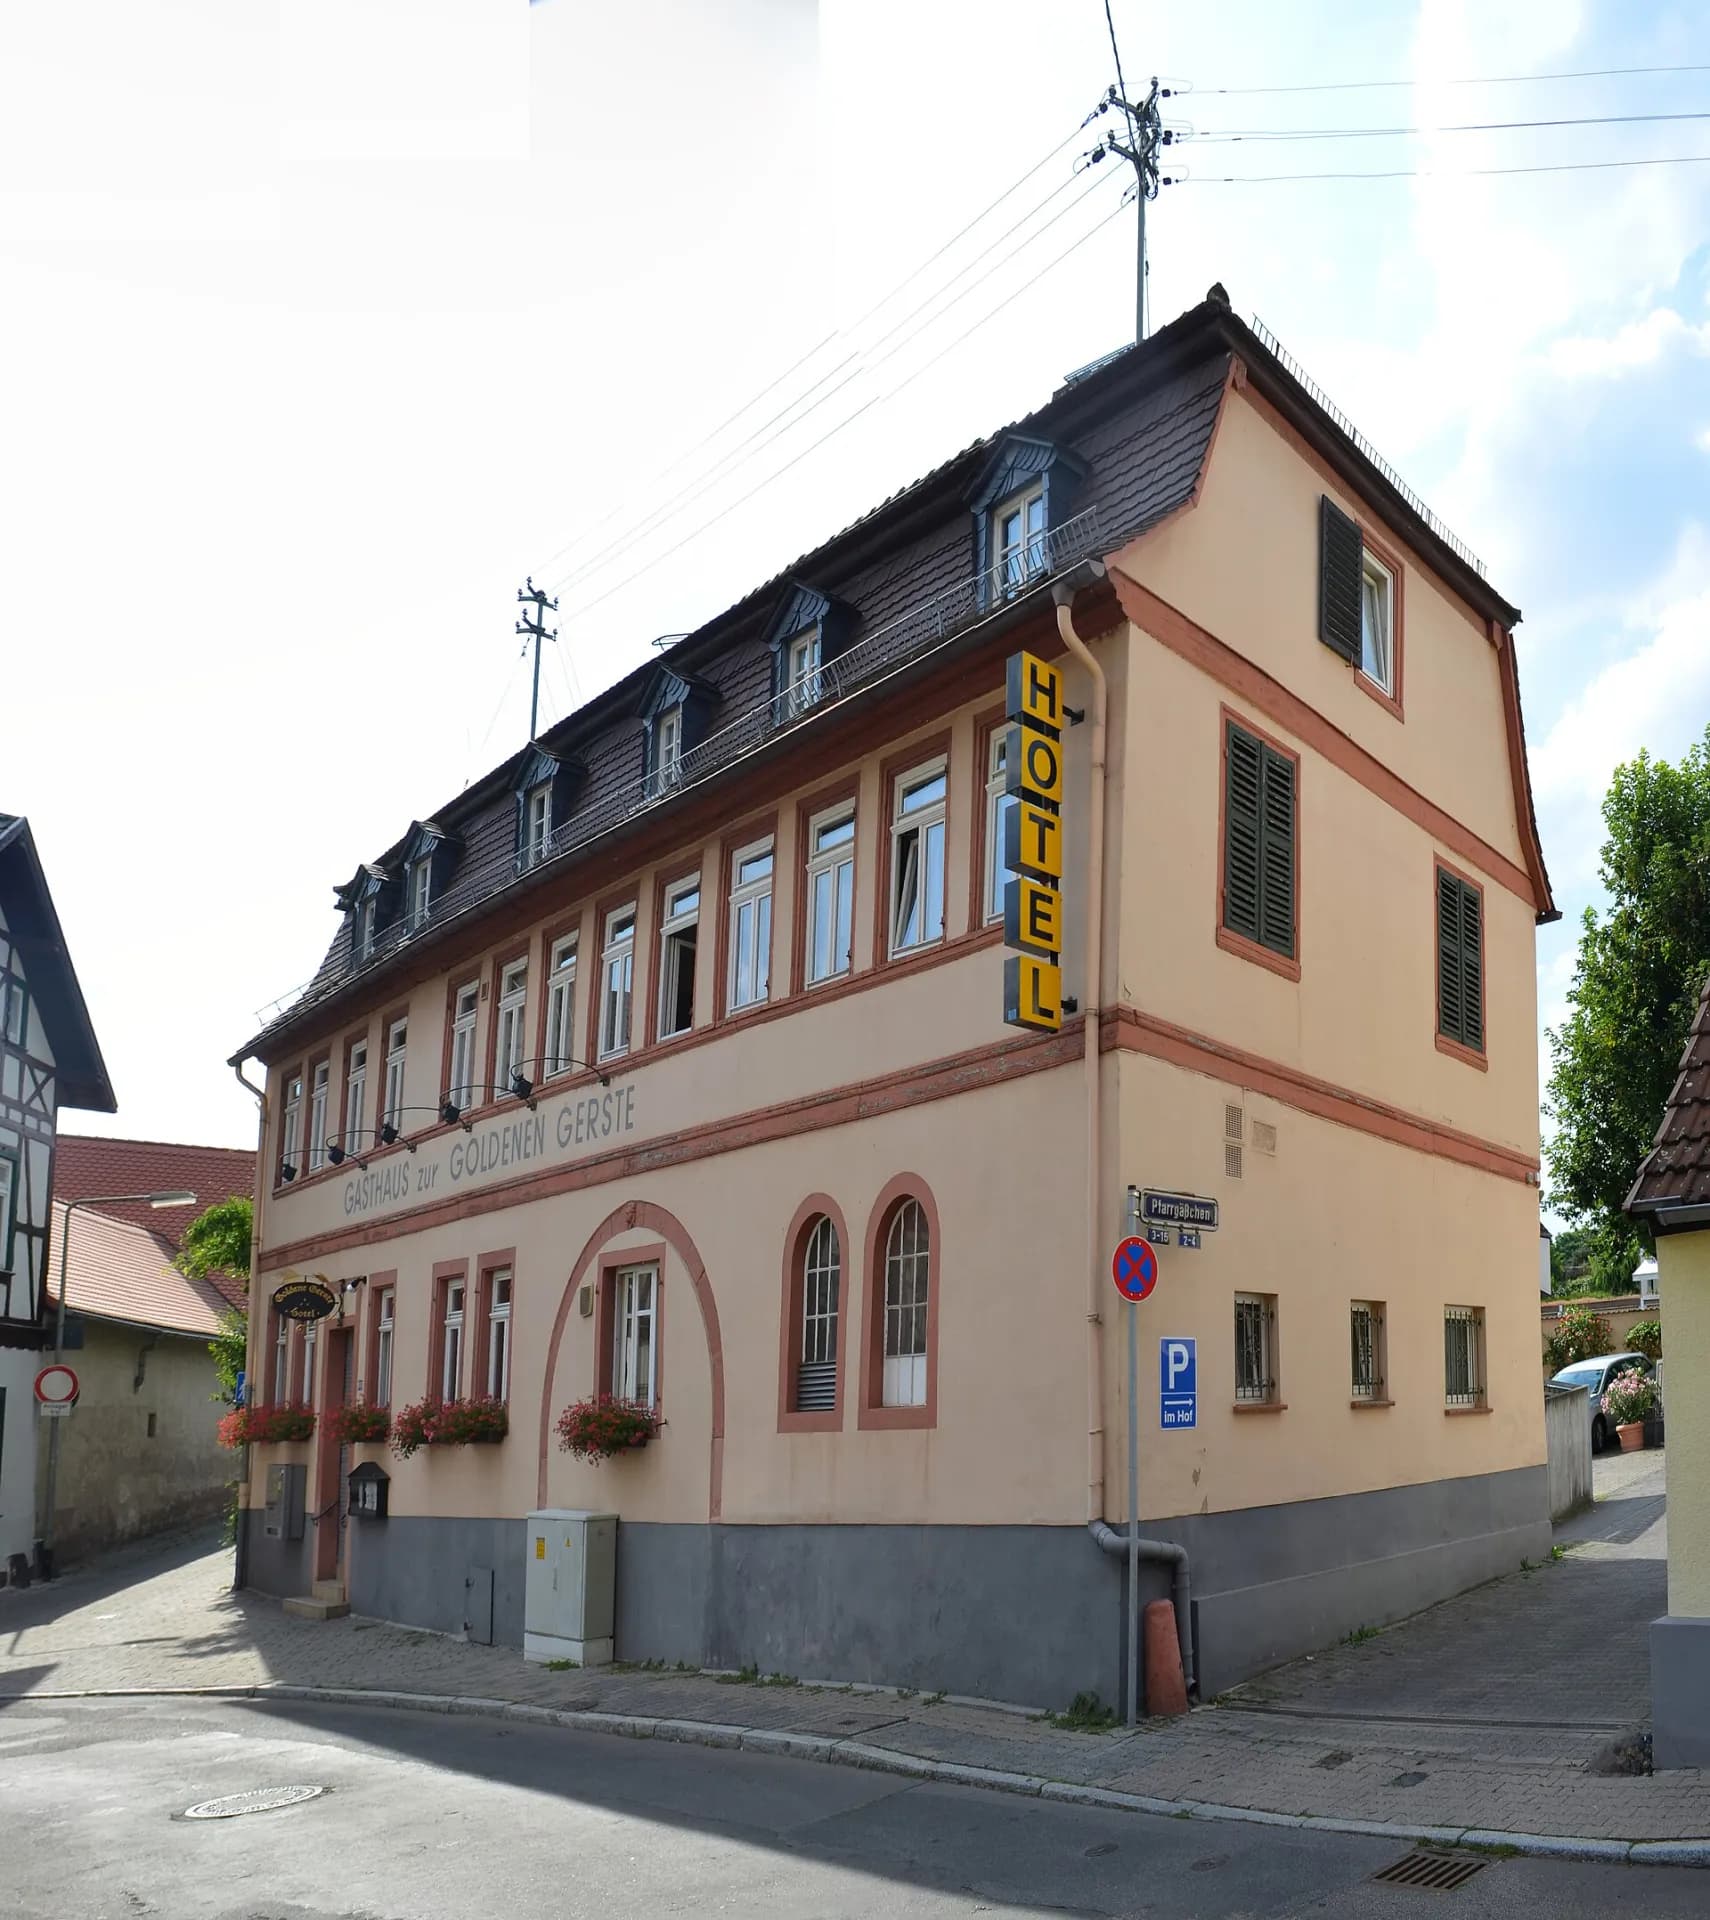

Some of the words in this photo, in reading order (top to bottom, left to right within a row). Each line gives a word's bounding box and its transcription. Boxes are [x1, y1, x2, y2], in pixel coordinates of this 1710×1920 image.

[1027, 662, 1056, 1020] HOTEL
[344, 1160, 410, 1216] GASTHAUS
[417, 1163, 439, 1192] zur
[450, 1114, 545, 1181] GOLDENEN
[556, 1085, 636, 1148] GERSTE
[1151, 1198, 1210, 1221] Pfarrgäßchen
[1152, 1230, 1169, 1242] 3-15
[1183, 1235, 1196, 1246] 2-4
[275, 1285, 307, 1303] Goldene
[1168, 1343, 1189, 1390] P
[1164, 1410, 1175, 1423] im
[1177, 1408, 1192, 1422] Hof
